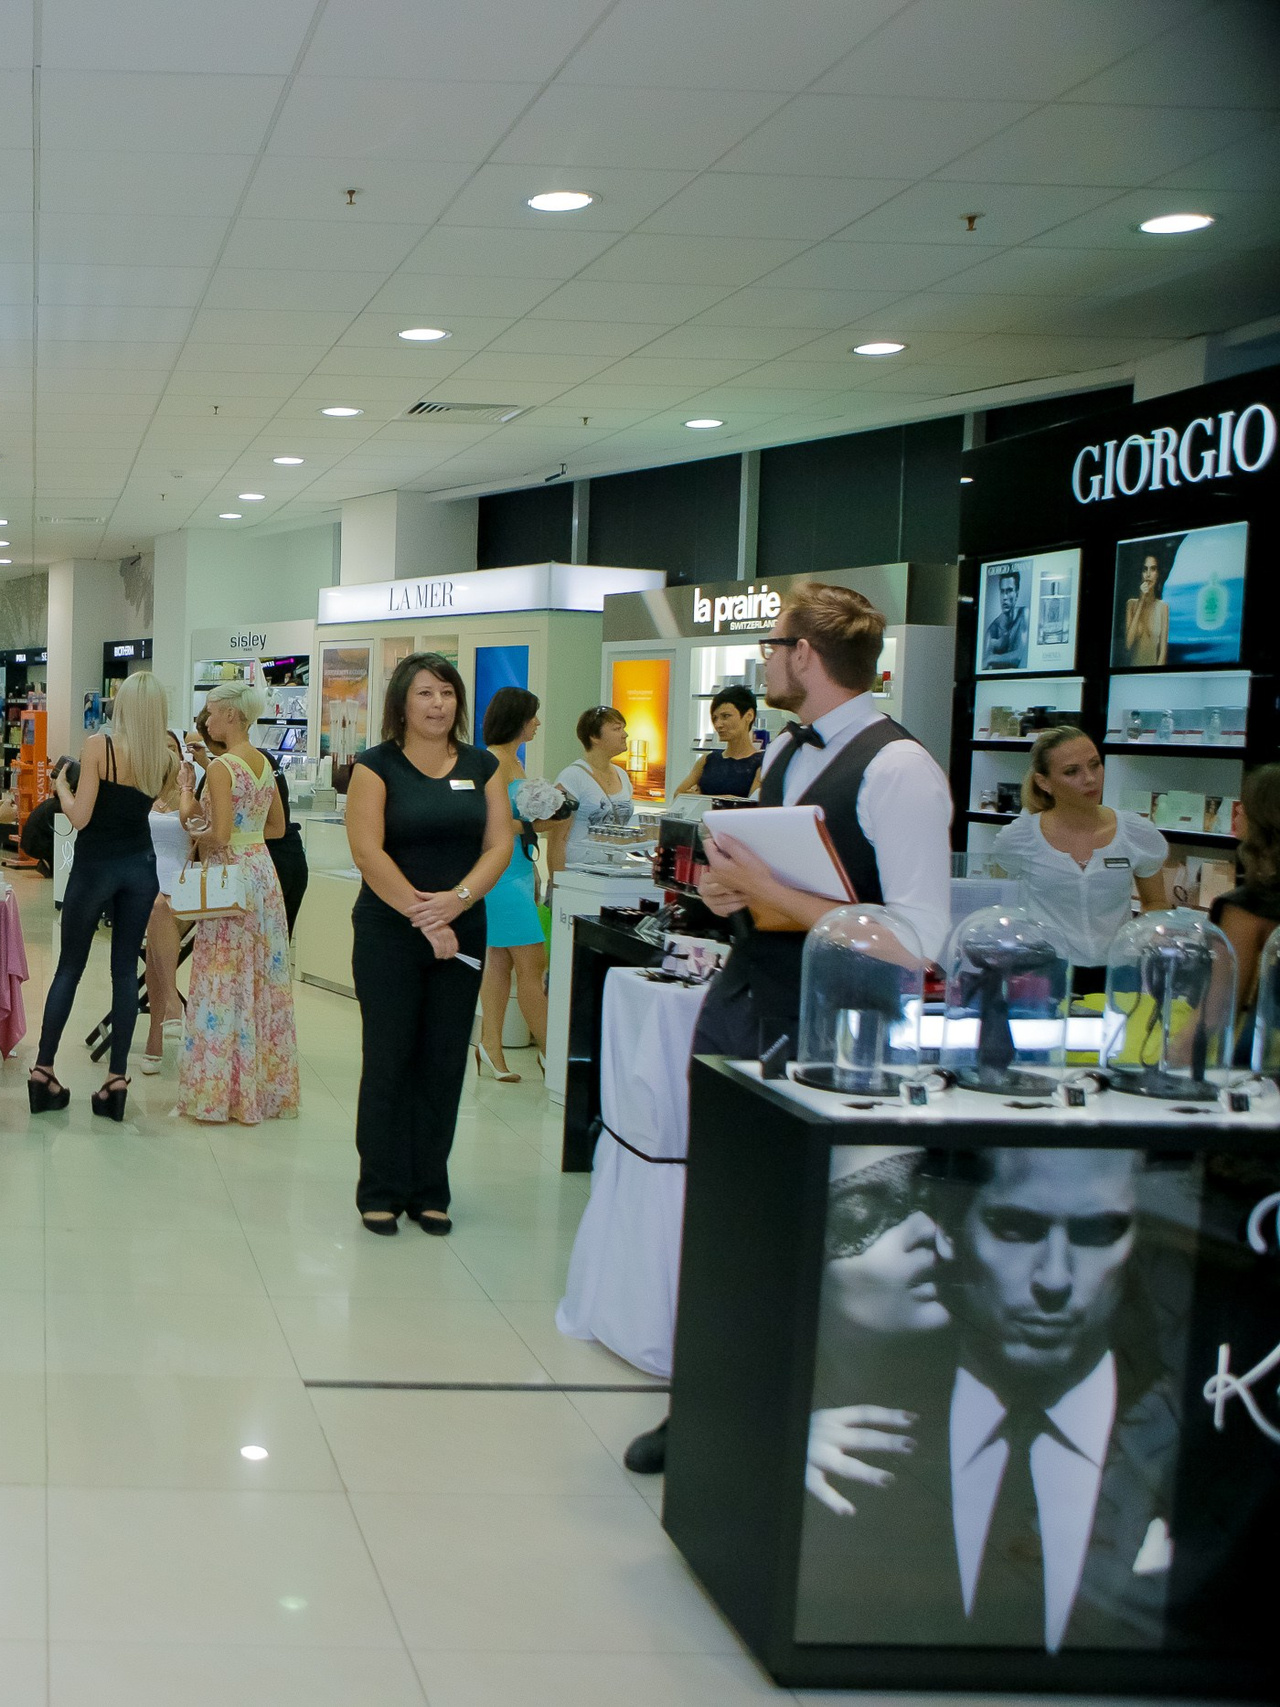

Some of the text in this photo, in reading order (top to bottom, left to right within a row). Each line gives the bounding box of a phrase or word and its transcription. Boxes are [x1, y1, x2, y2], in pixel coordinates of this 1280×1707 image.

[1072, 403, 1278, 504] GIORGIO
[388, 582, 454, 611] LA MER
[693, 585, 781, 633] la prairie
[230, 631, 267, 650] sisley
